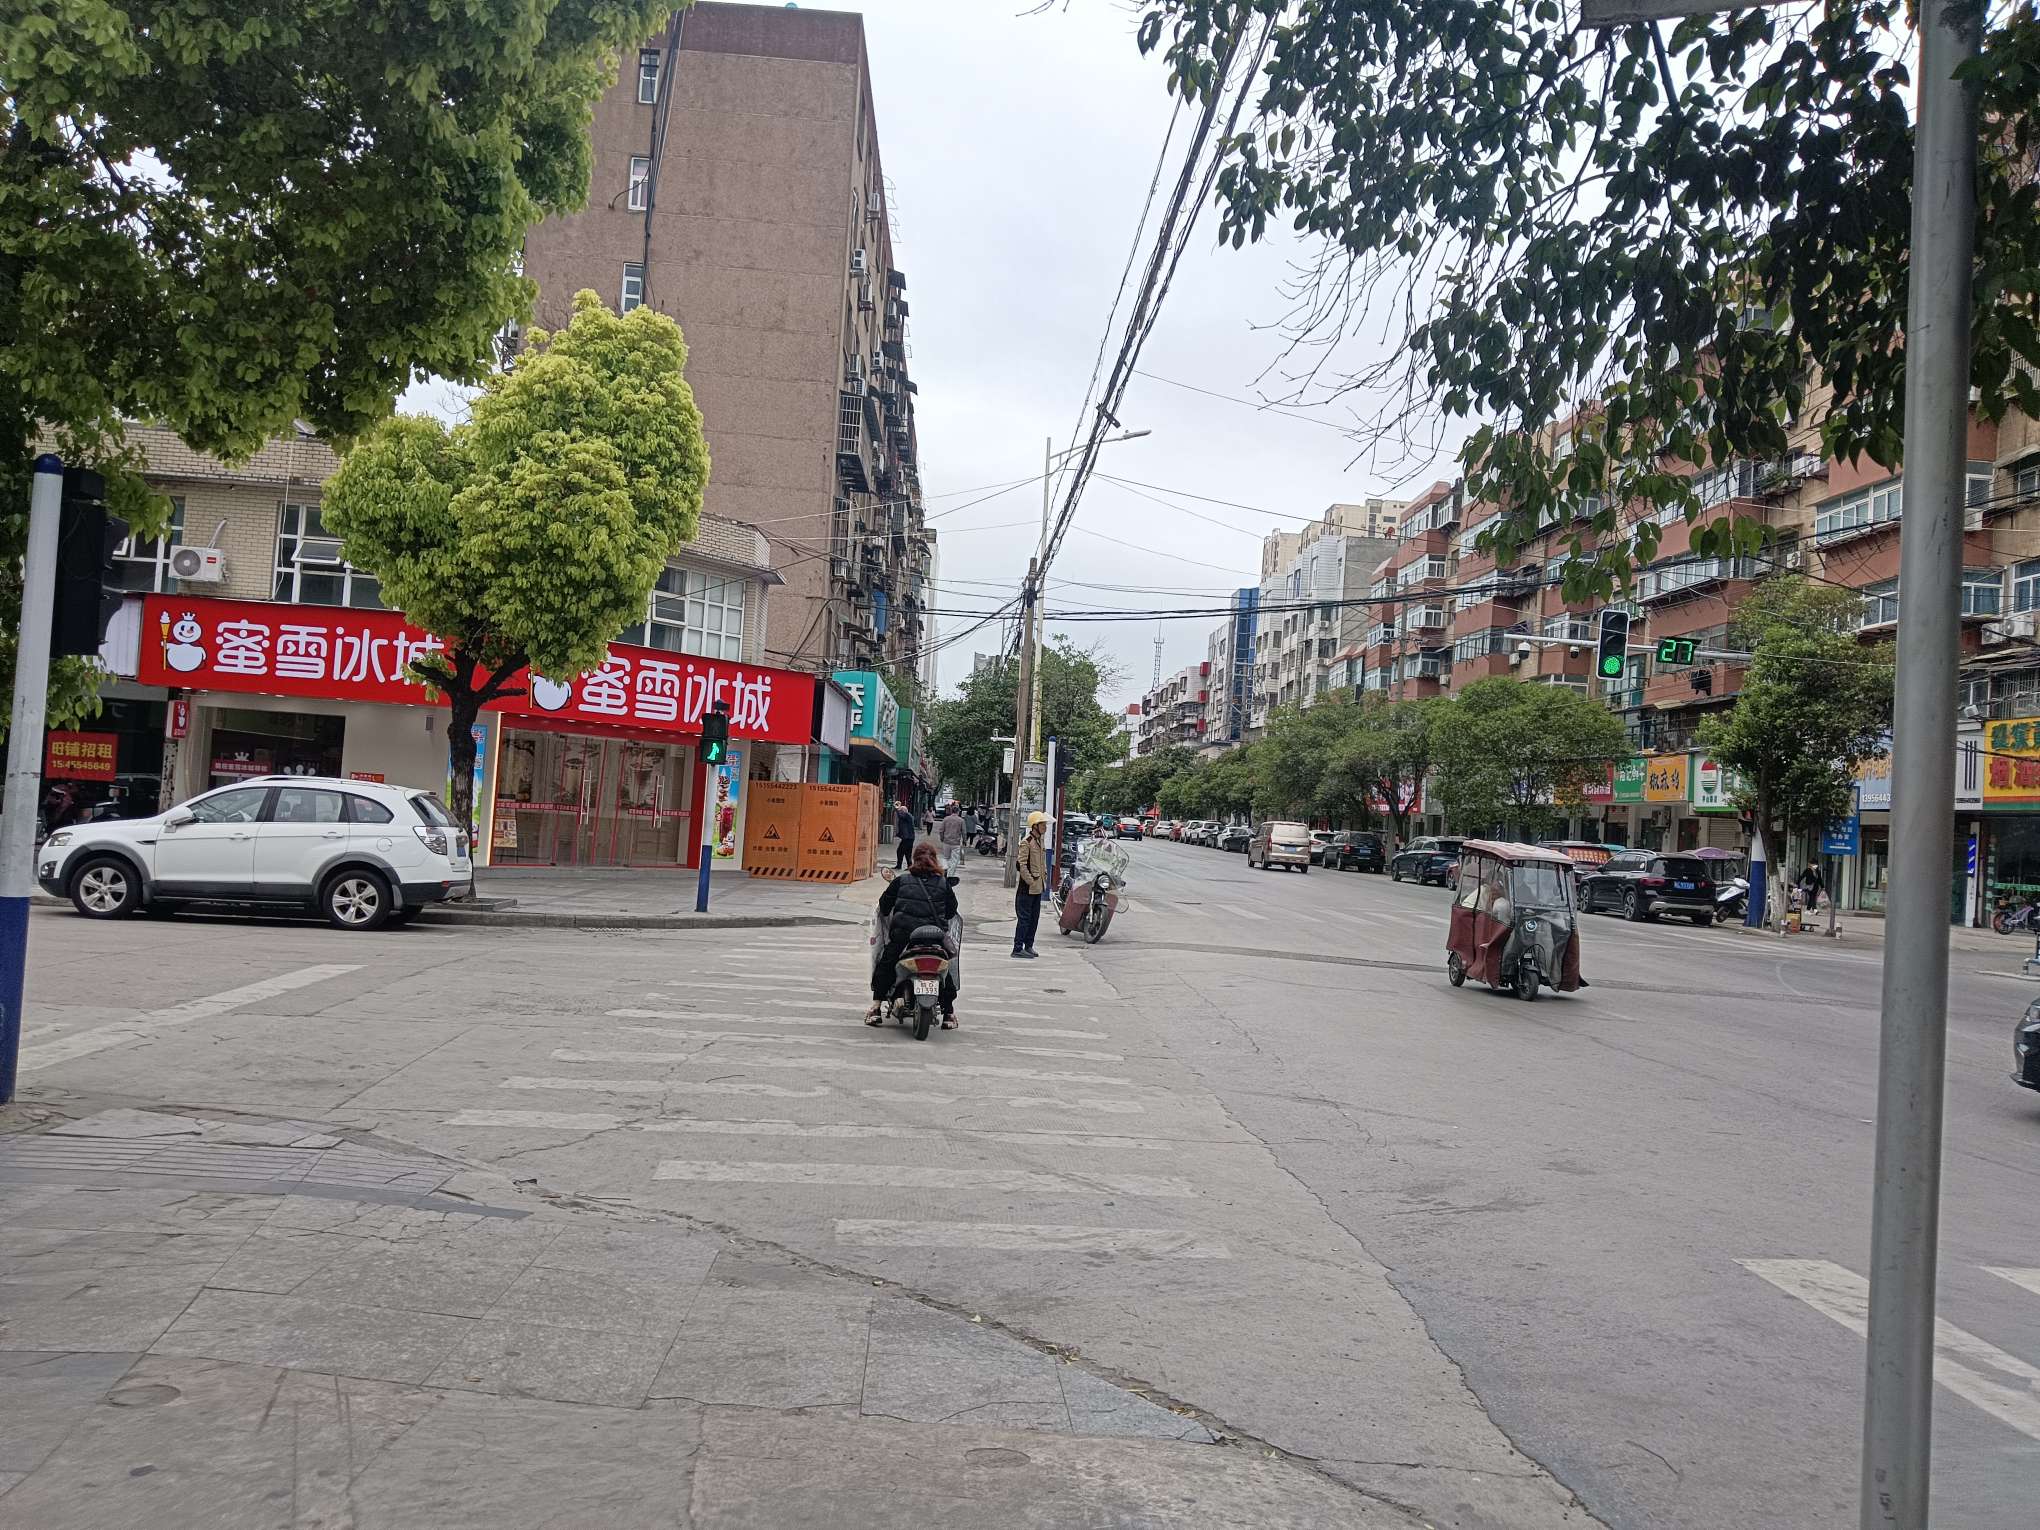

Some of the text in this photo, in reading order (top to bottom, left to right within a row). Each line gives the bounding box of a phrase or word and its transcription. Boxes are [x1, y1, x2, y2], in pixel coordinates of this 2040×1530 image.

[1661, 639, 1693, 662] 27
[578, 650, 772, 732] 蜜雪冰城
